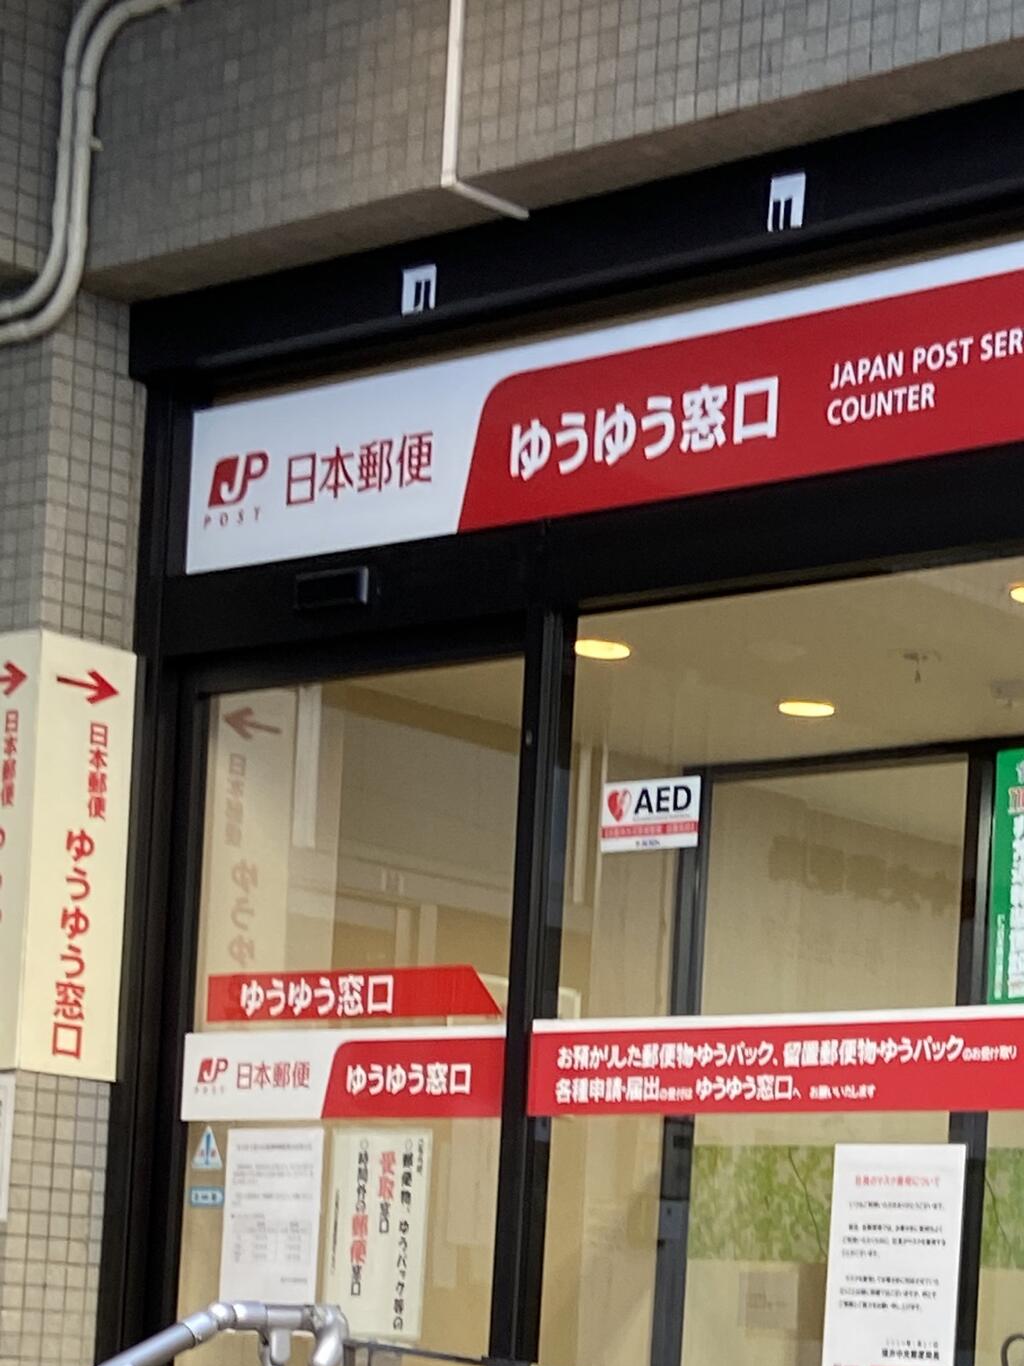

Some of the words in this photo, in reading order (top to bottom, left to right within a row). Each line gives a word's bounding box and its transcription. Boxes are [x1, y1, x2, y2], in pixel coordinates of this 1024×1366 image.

[830, 350, 903, 391] JAPAN
[912, 337, 974, 372] POST
[510, 376, 779, 482] ゆうゆう窓口
[826, 383, 936, 426] COUNTER
[286, 431, 433, 507] 日本郵便
[87, 721, 109, 822] 日本郵便
[634, 785, 692, 815] AED
[51, 829, 96, 1061] ゆうゆう窓口
[240, 973, 395, 1018] ゆうゆう窓口
[236, 1061, 311, 1090] 日本郵便
[346, 1062, 472, 1096] ゆうゆう窓口
